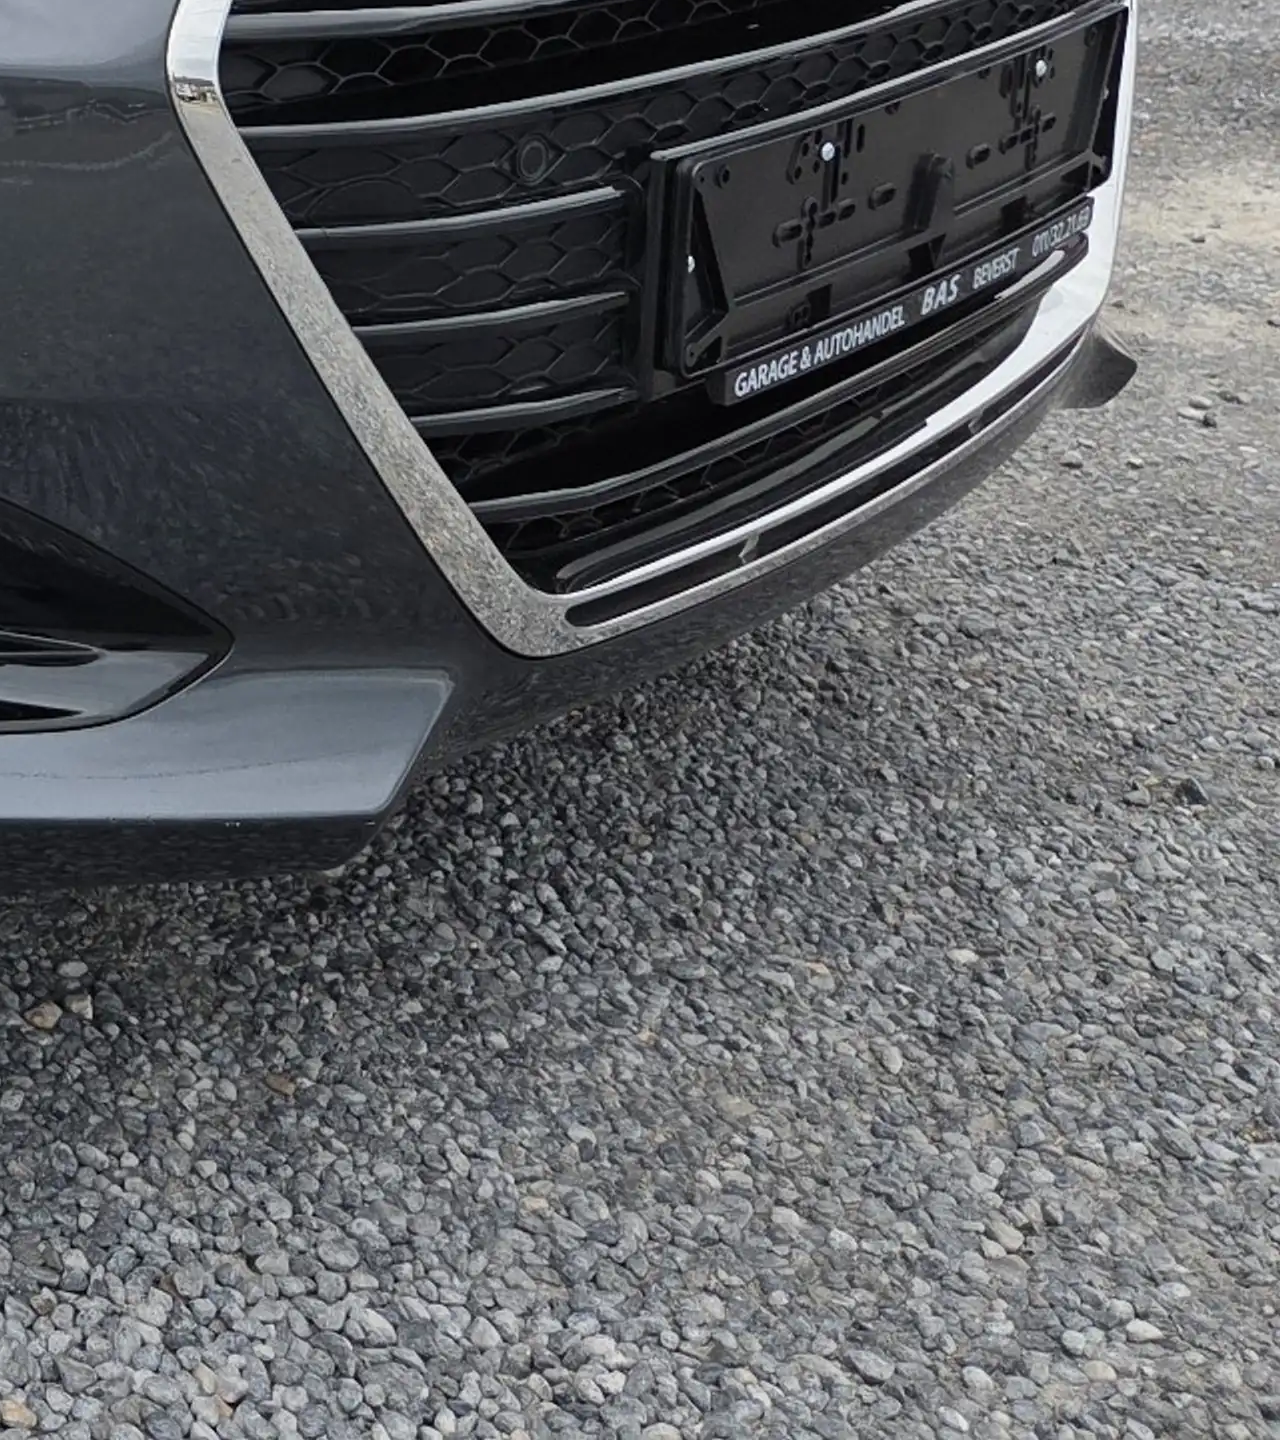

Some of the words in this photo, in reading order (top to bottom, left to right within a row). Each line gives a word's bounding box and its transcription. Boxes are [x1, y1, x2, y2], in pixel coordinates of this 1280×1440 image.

[734, 351, 799, 397] GARAGE
[799, 345, 812, 371] &
[814, 305, 906, 365] AUTOHANDEL
[921, 274, 962, 316] BAS
